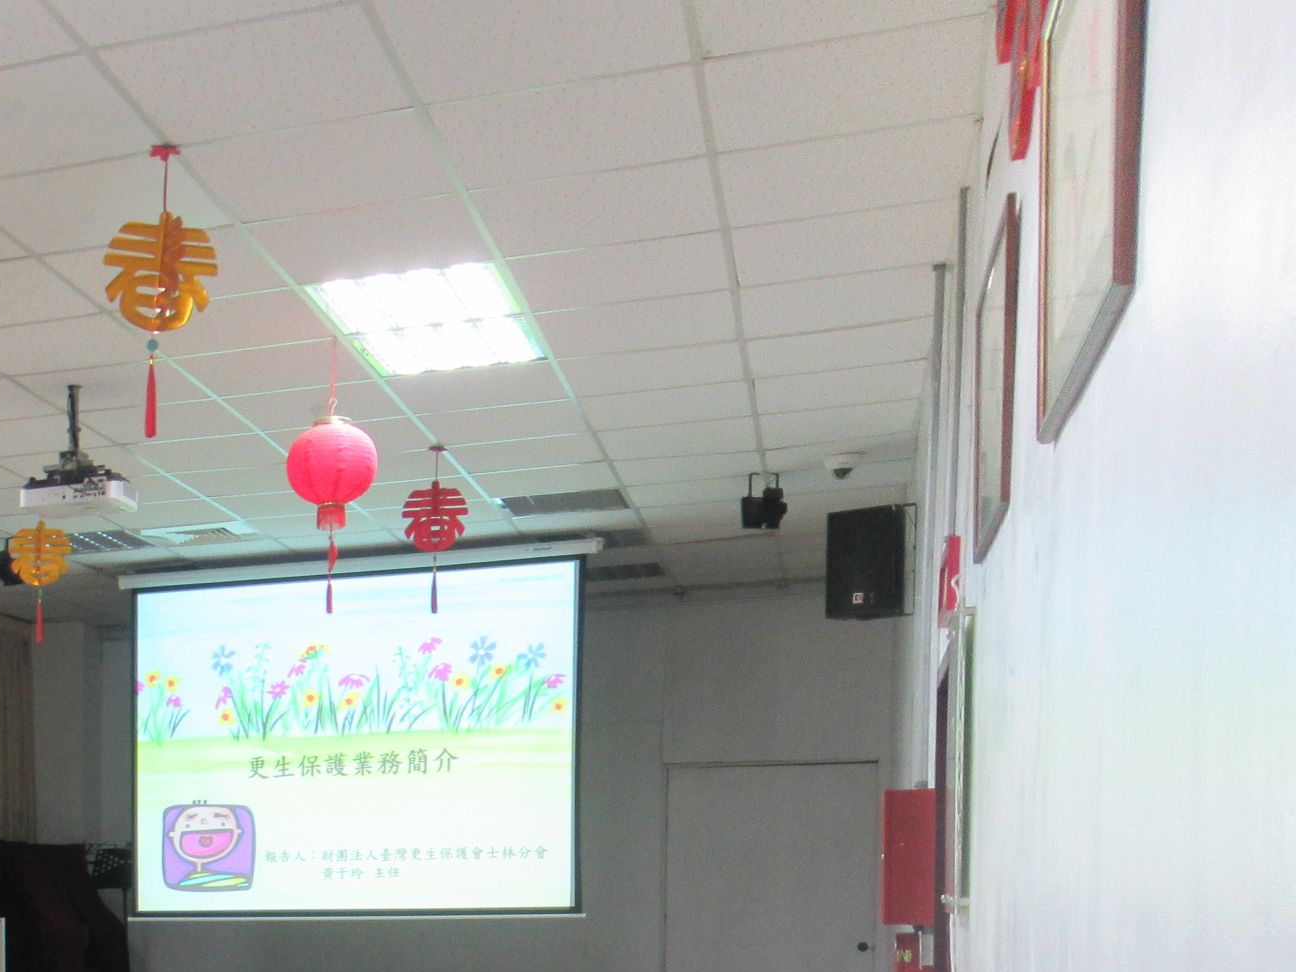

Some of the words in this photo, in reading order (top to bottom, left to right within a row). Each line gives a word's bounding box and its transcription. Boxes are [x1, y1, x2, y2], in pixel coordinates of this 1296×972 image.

[401, 480, 468, 552] 春
[247, 748, 461, 780] 更生保護業務簡介
[374, 867, 401, 878] 主任
